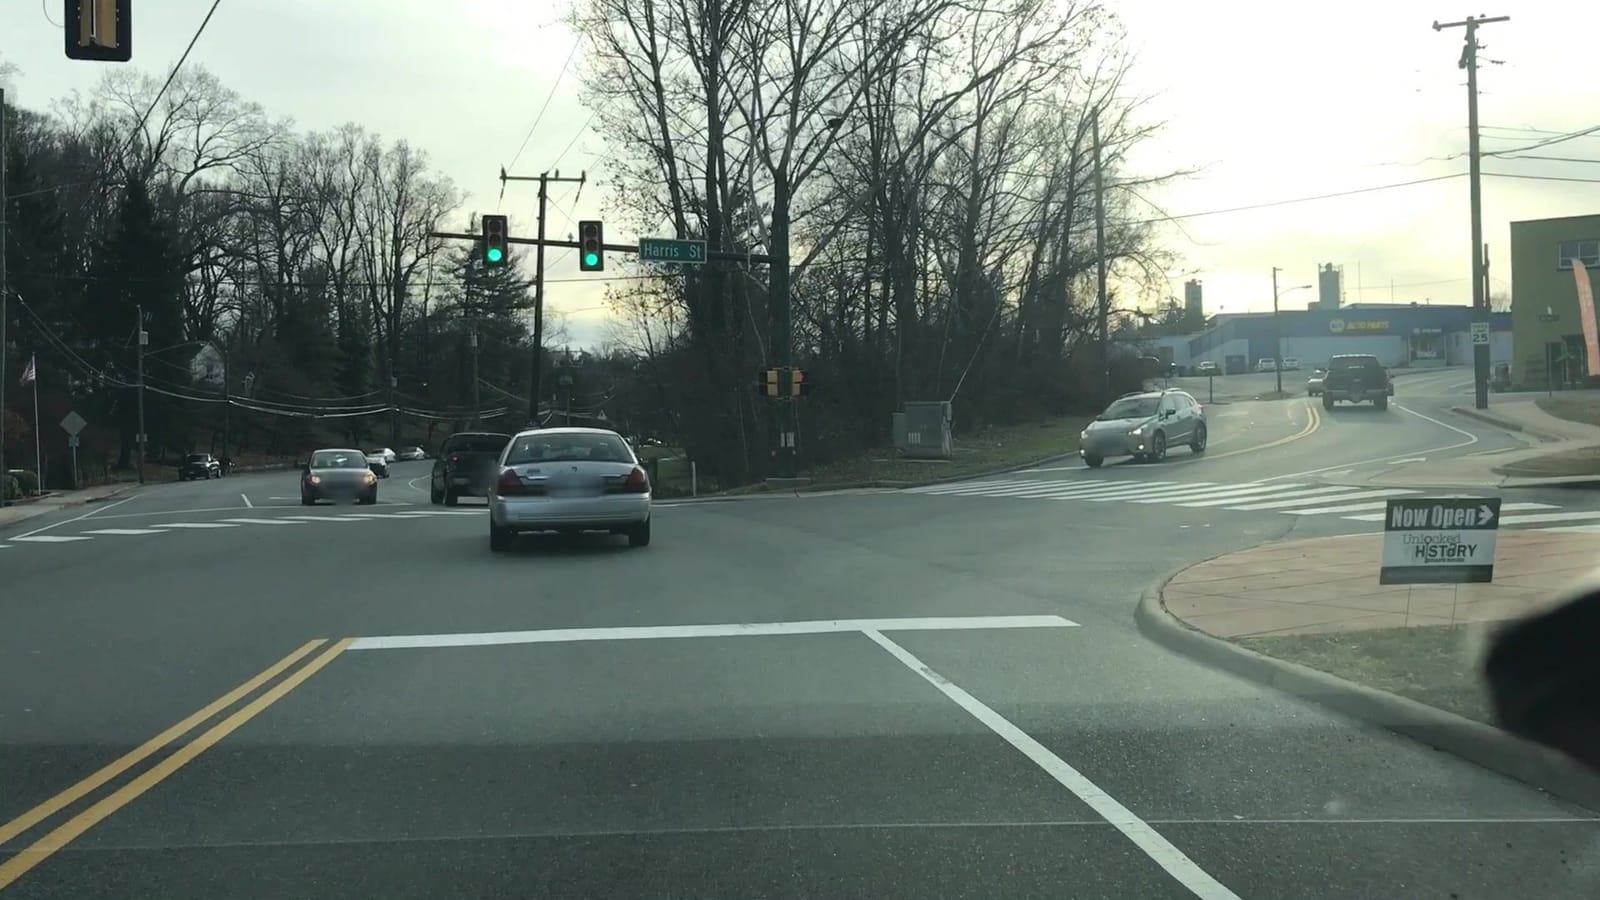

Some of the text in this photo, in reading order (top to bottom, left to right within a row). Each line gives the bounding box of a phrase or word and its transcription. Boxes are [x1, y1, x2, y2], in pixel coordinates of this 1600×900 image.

[644, 243, 702, 258] Harris St
[1472, 334, 1488, 343] 25
[1392, 505, 1477, 529] Now Open
[1402, 533, 1462, 545] Unlocked
